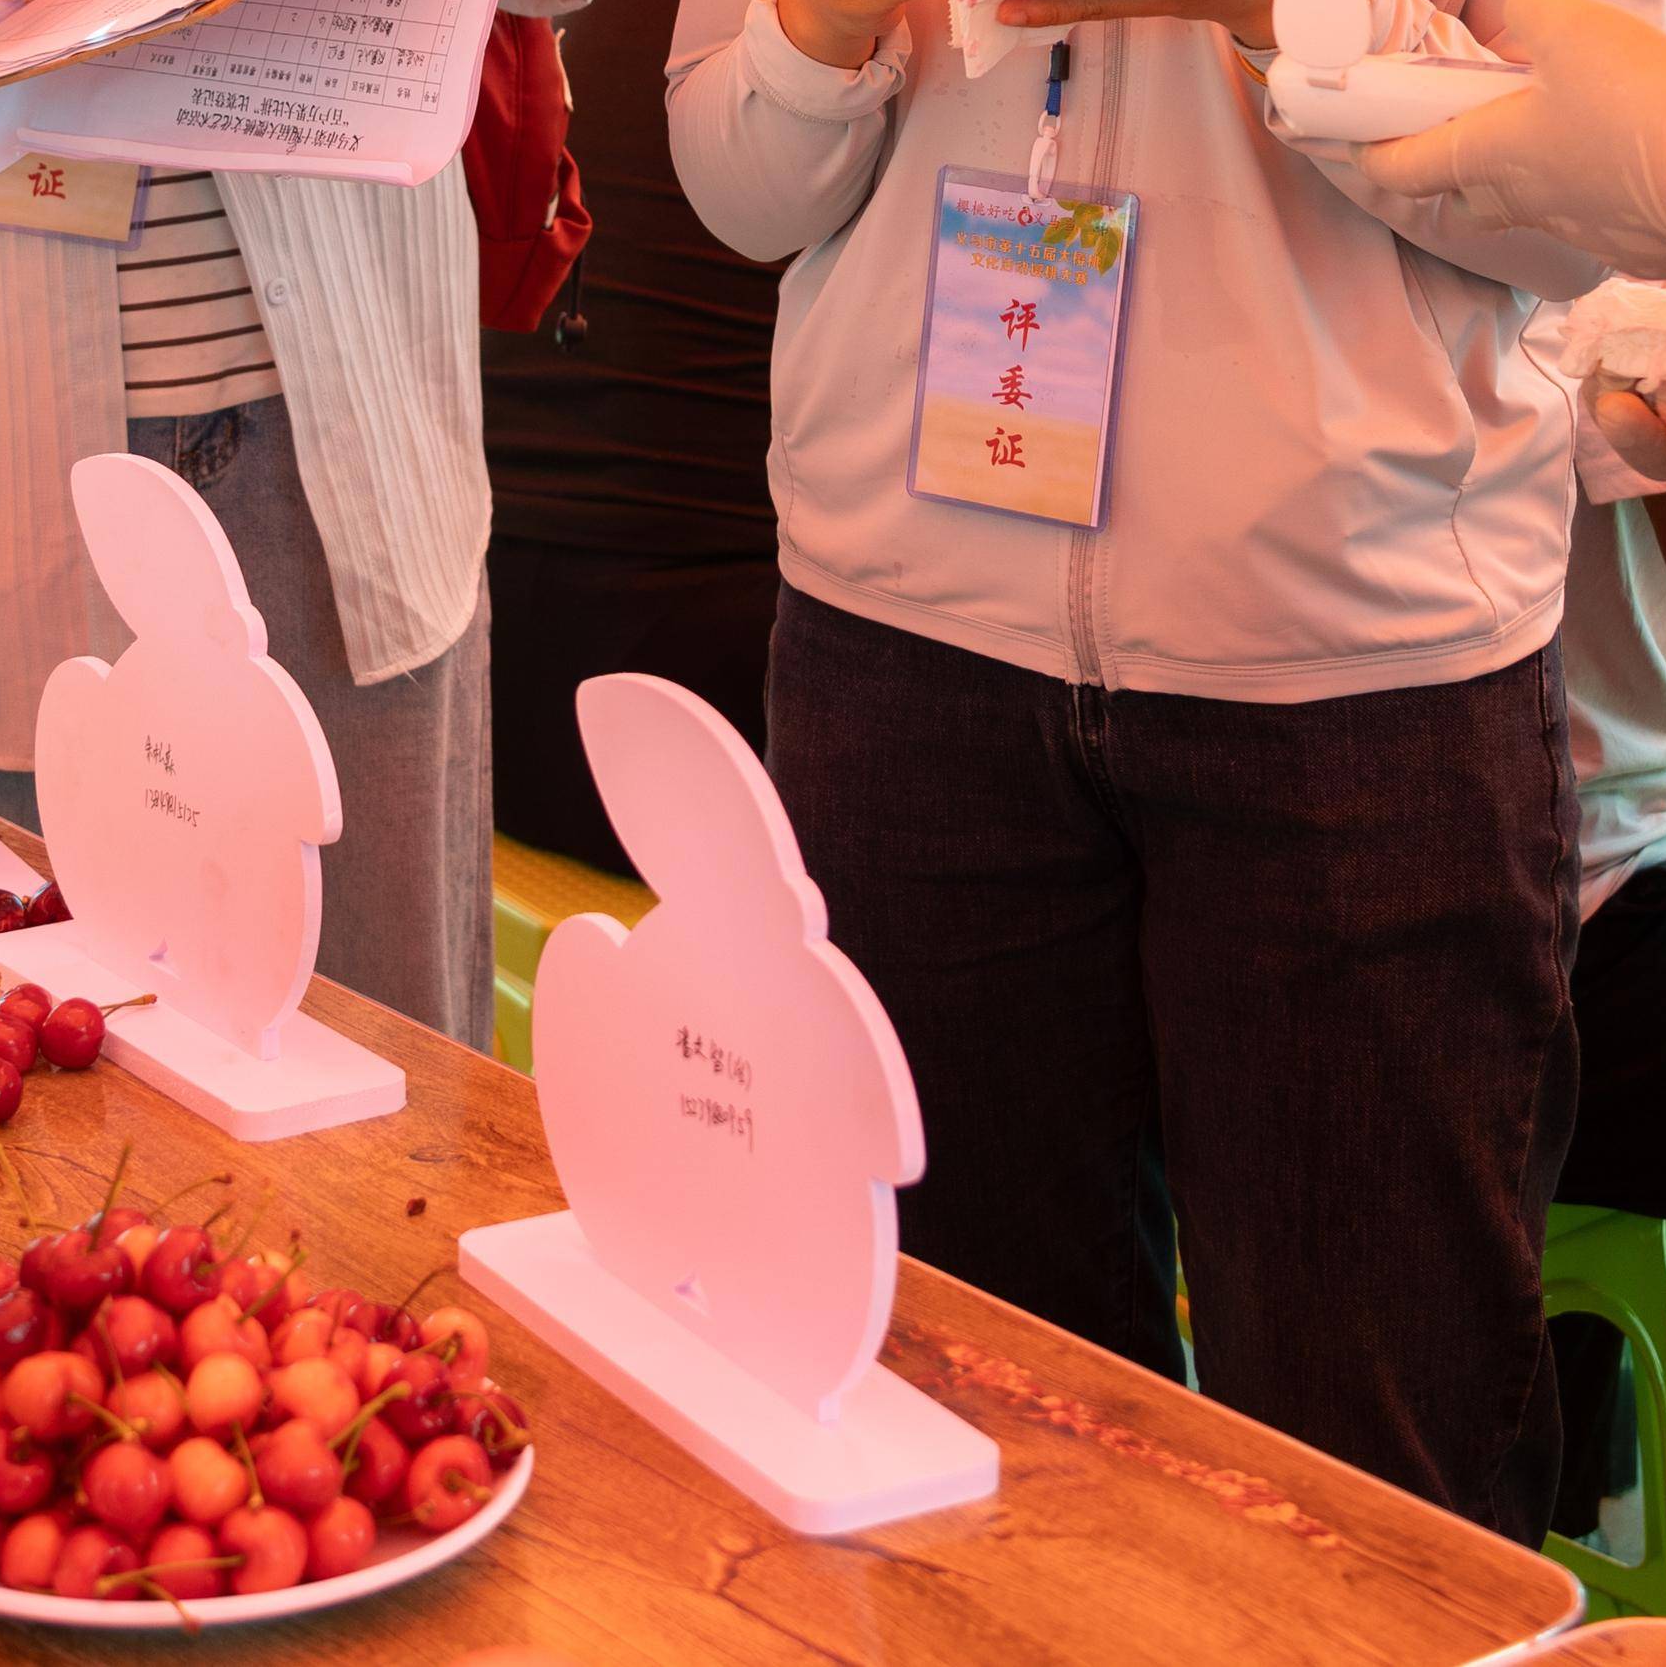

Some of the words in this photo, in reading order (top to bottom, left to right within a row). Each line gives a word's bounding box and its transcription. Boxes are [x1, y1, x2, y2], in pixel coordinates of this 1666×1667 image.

[28, 163, 67, 200] 证
[984, 299, 1040, 469] 评委证
